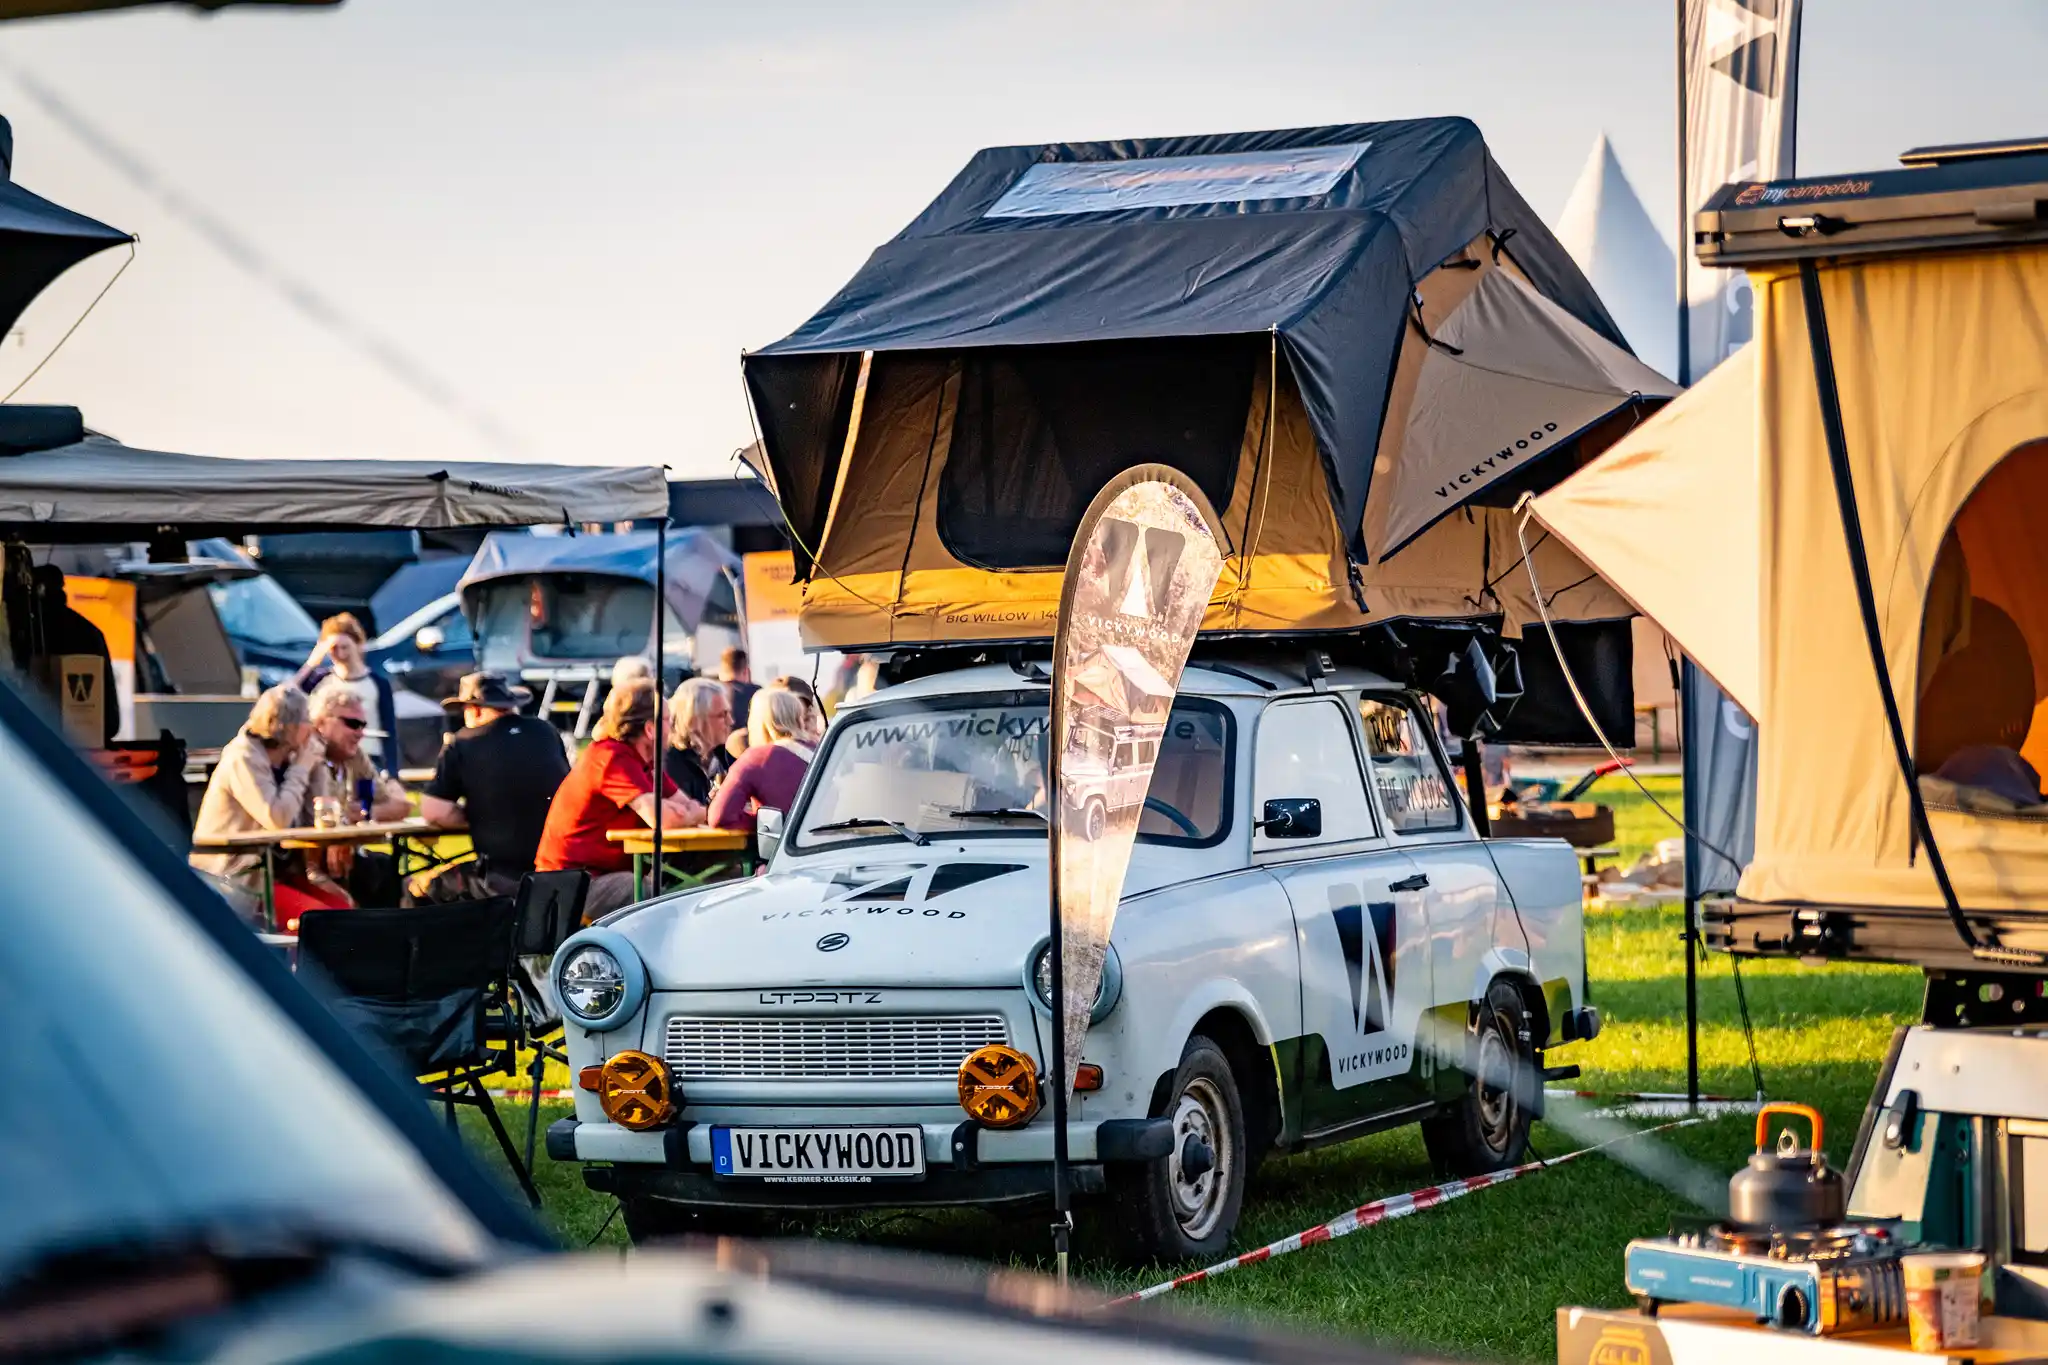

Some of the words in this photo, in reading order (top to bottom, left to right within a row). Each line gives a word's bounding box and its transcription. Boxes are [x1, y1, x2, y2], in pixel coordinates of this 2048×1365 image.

[1761, 179, 1873, 205] mycamperbox
[1435, 422, 1558, 498] VICKYWOOD
[946, 614, 969, 624] BIG
[973, 611, 1029, 623] WILLOW
[1088, 615, 1180, 643] VICKYWOOD
[762, 907, 966, 922] VICKYWOOD
[1338, 1043, 1408, 1074] VICKYWOOD
[719, 1155, 728, 1166] D
[736, 1132, 915, 1169] VICKYWOOD
[763, 1175, 872, 1184] www.KERMER-KLASSIK.de
